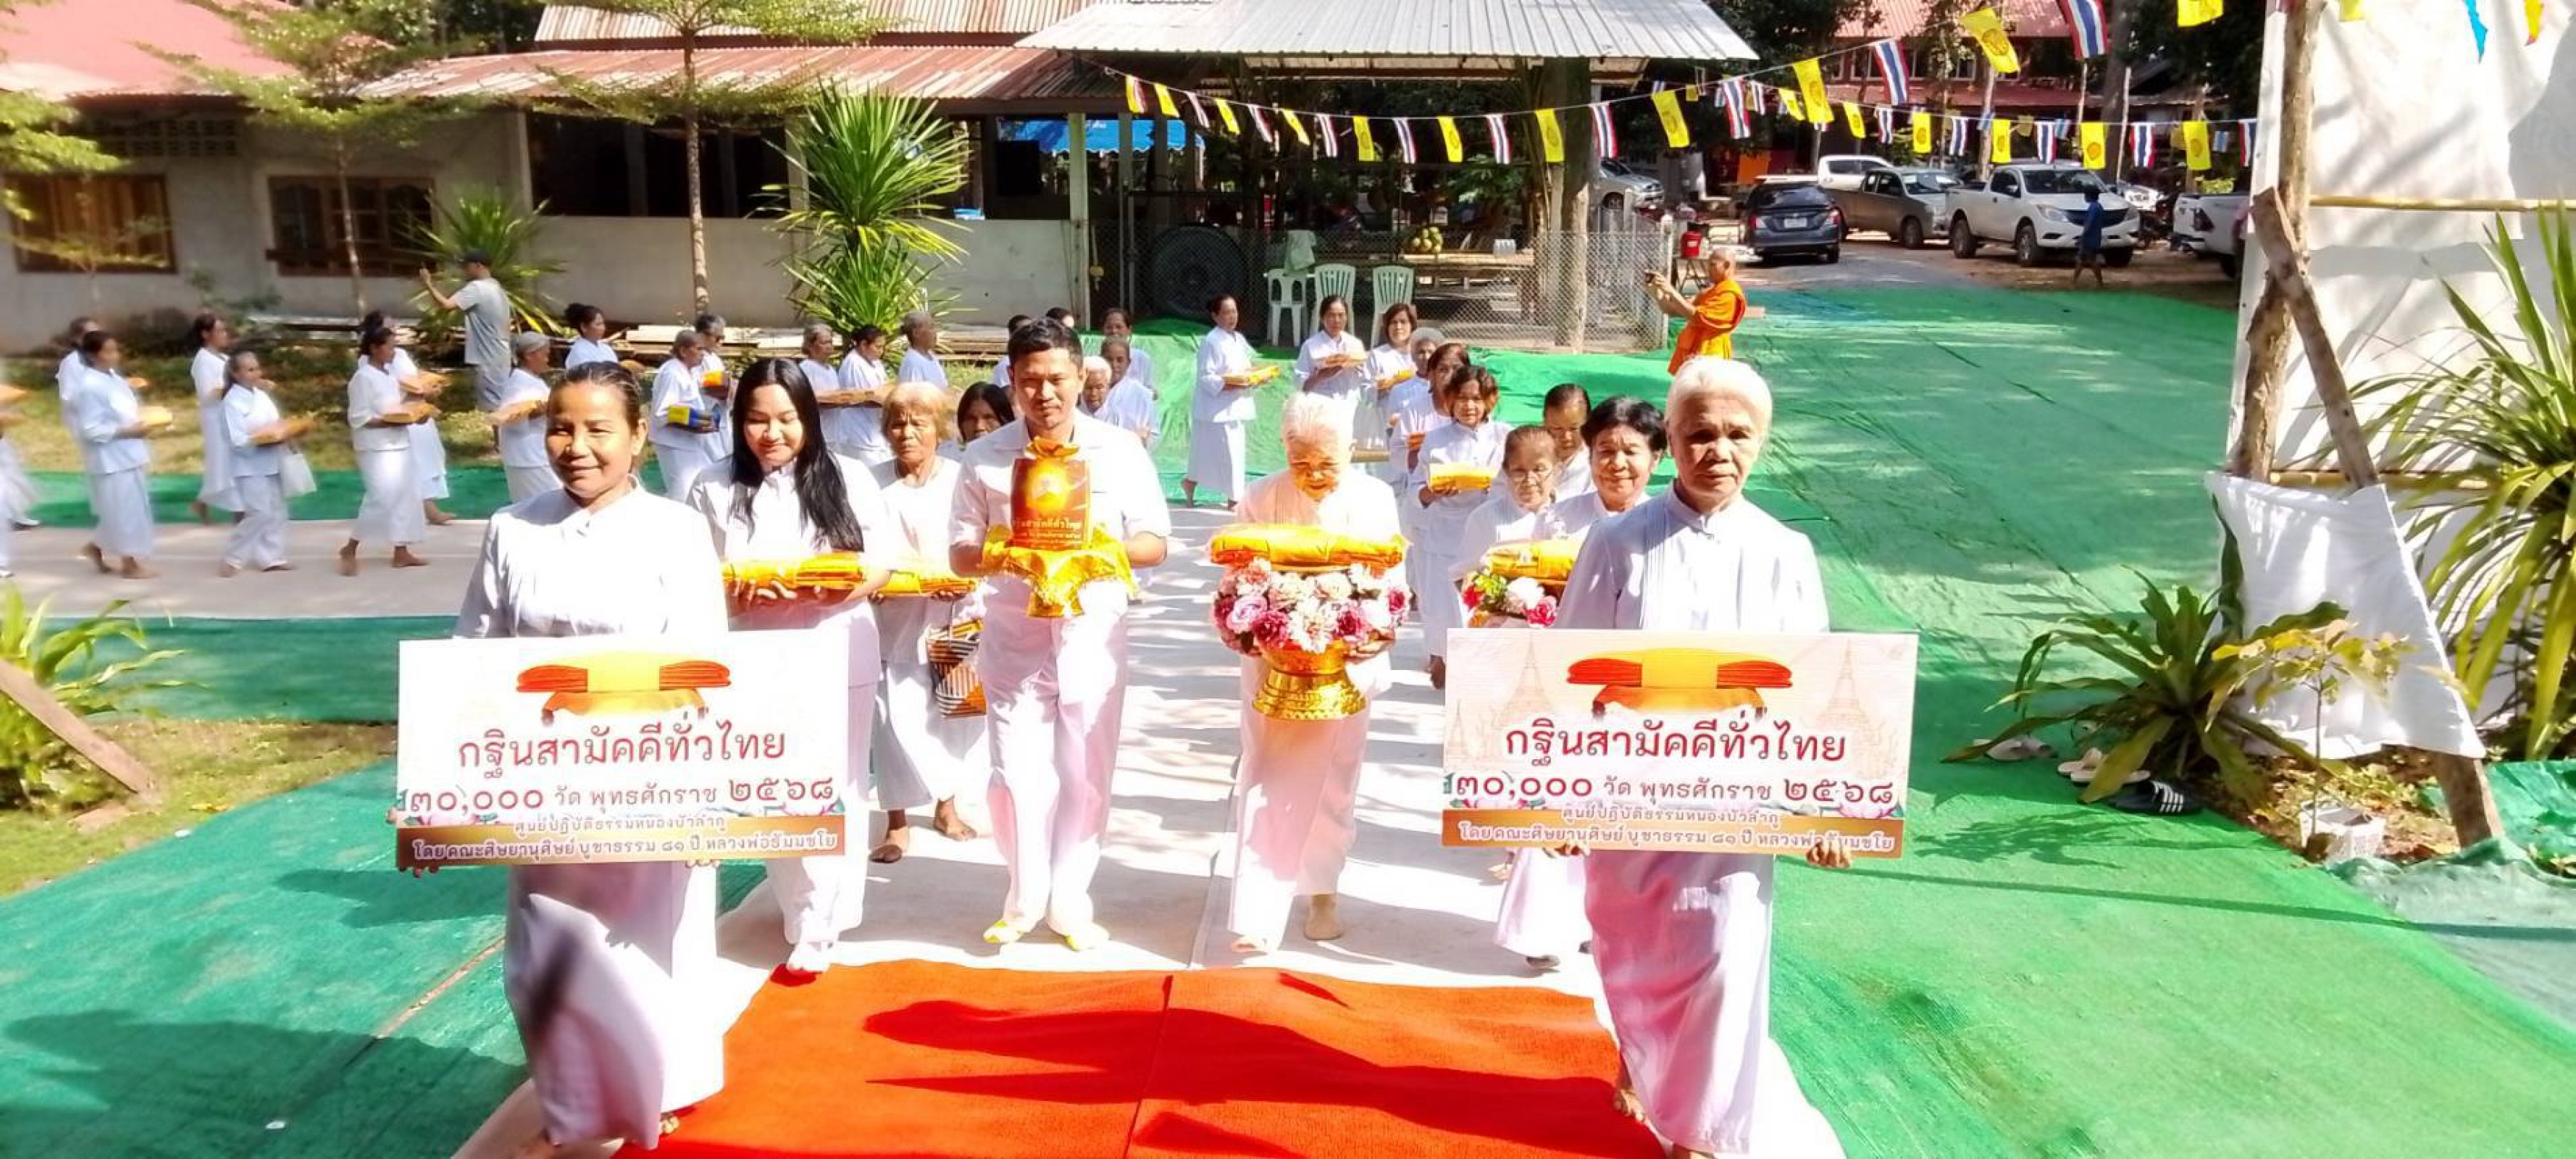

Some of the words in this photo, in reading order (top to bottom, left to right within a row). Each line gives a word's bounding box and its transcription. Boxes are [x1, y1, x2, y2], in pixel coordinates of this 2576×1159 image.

[459, 711, 785, 779] กฐินสามัคคีทั่วไทย
[1506, 709, 1846, 766] กฐินสามัคคีทั่วไทย
[409, 786, 544, 814] ๓๐,๐๐๐
[554, 784, 582, 806] วัด
[590, 782, 718, 816] พุทธศักราช
[728, 775, 835, 803] ๒๕๖๘
[1456, 773, 1593, 800] ๓๐,๐๐๐
[1605, 776, 1632, 796] วัด
[1641, 777, 1773, 807] พุทธศักราช
[1783, 777, 1894, 805] ๒๕๖๘
[414, 841, 446, 858] โดย
[580, 840, 656, 858] บูชาธรรม
[690, 835, 701, 850] ปี
[1461, 823, 1491, 838] โดย
[1628, 831, 1706, 846] บูชาธรรม
[1742, 829, 1752, 843] ปี
